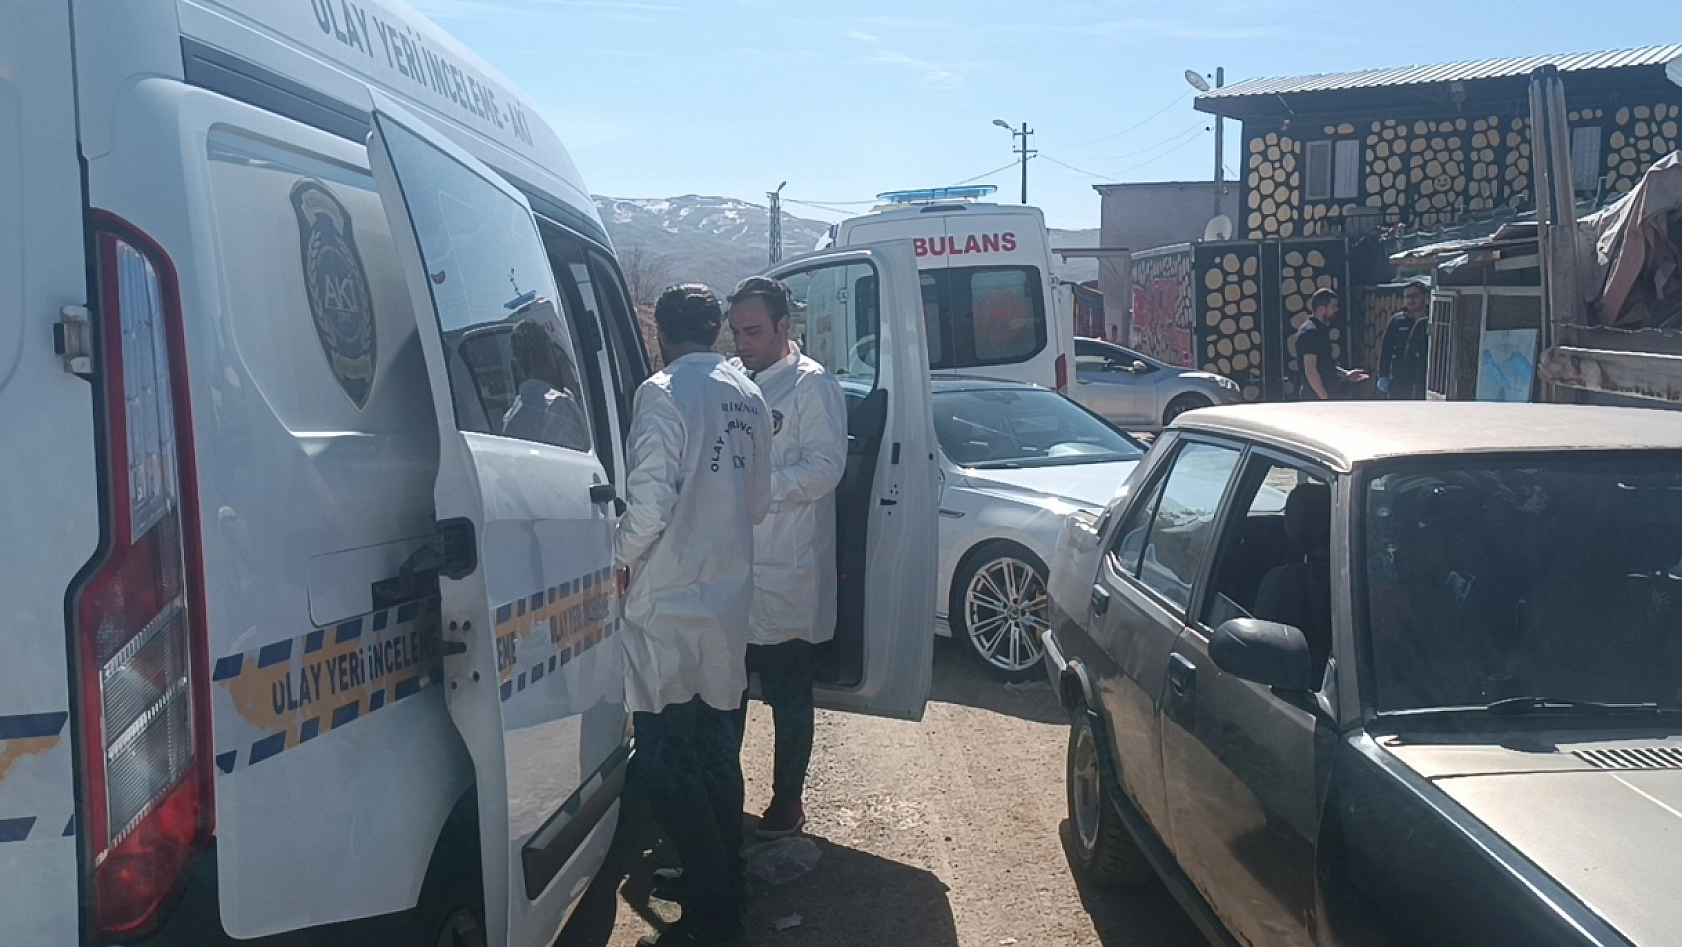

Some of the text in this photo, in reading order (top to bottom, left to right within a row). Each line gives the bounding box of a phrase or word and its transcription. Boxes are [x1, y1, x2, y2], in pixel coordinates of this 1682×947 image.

[311, 0, 374, 58] OLAY
[912, 232, 1017, 257] BULANS
[326, 648, 366, 695] YERİ
